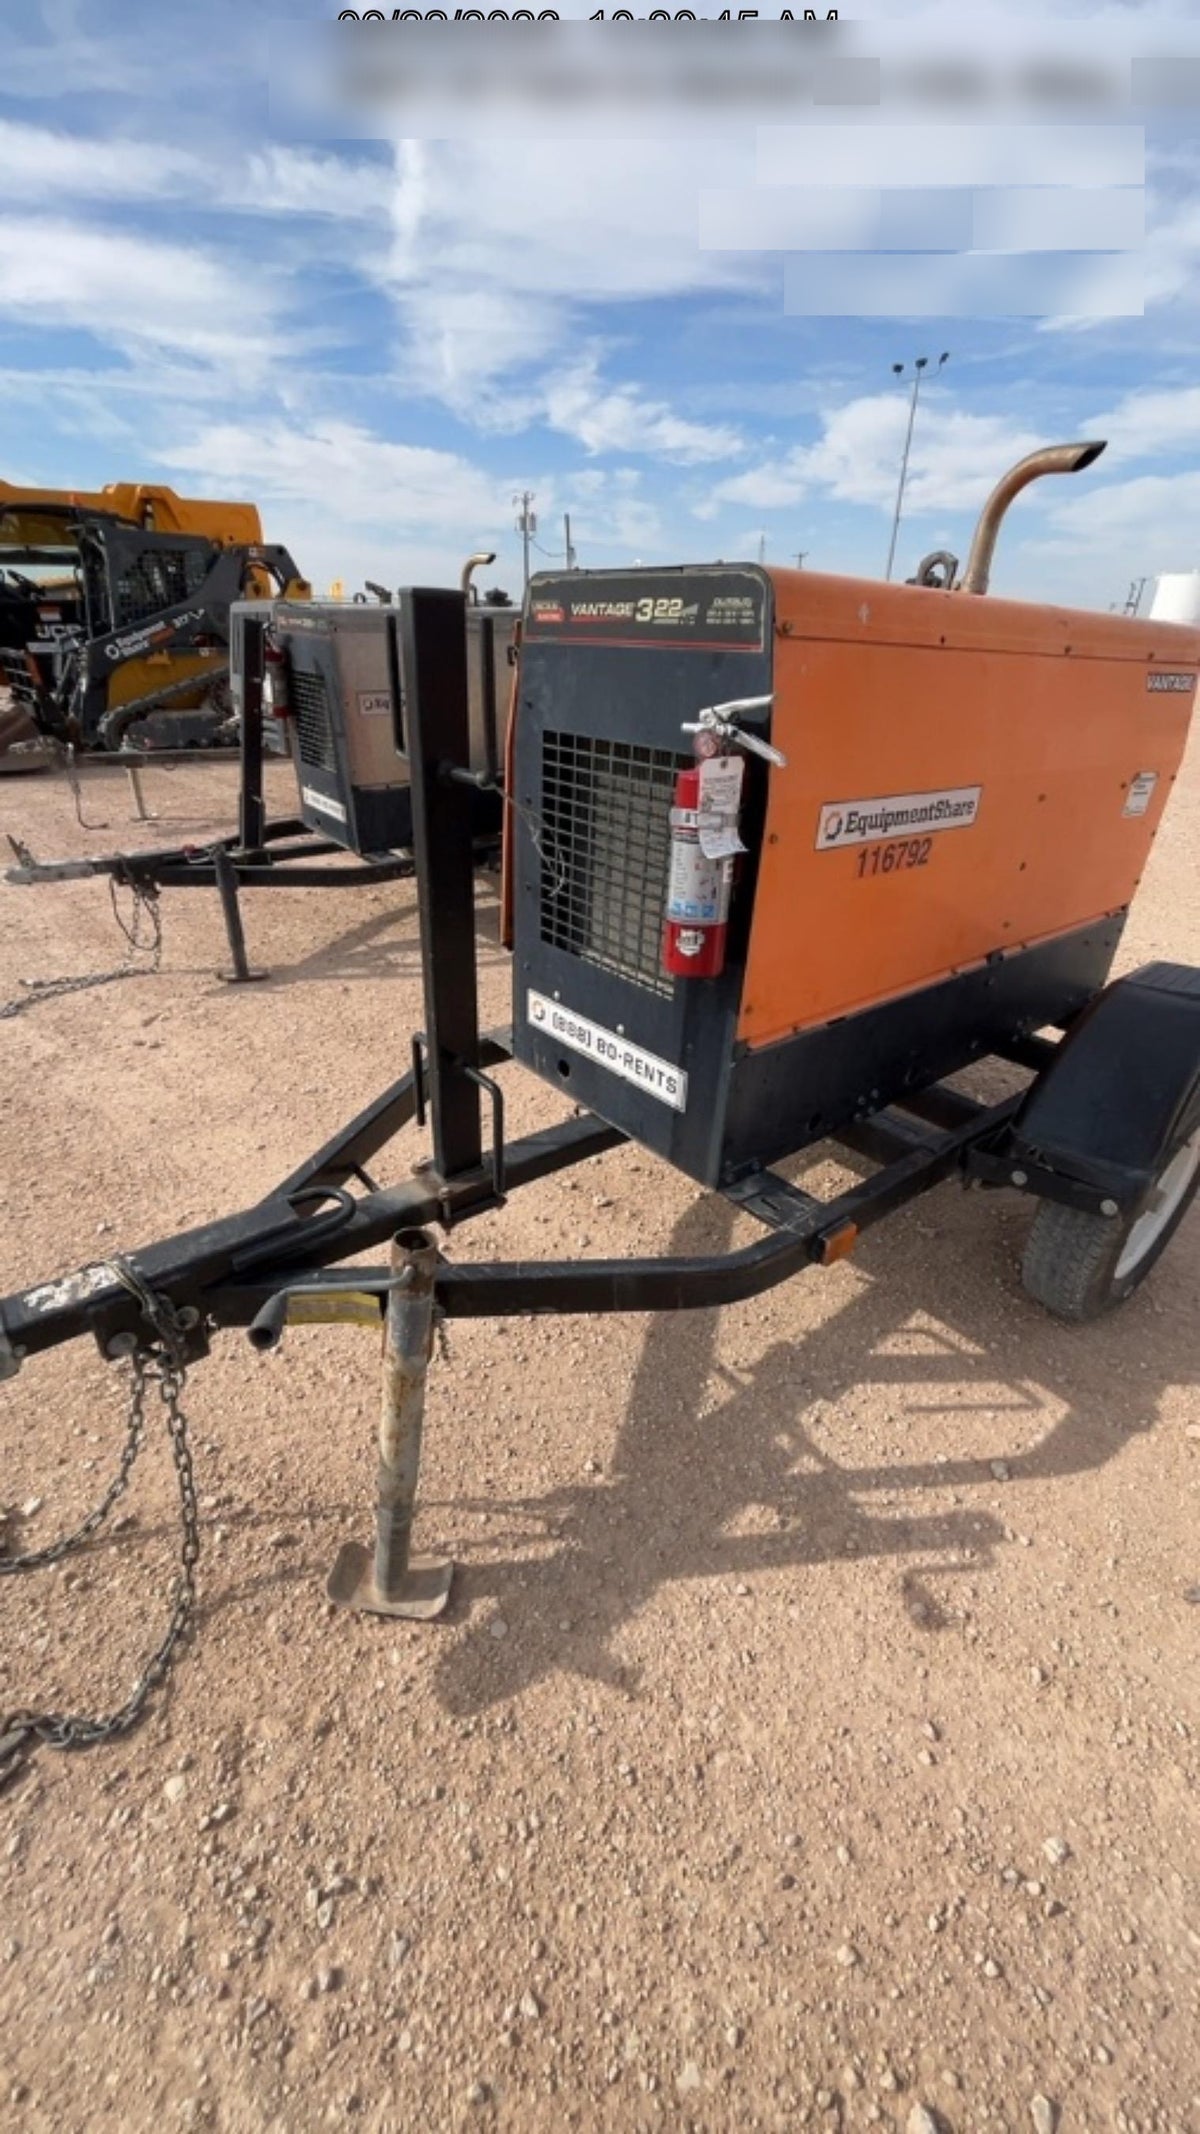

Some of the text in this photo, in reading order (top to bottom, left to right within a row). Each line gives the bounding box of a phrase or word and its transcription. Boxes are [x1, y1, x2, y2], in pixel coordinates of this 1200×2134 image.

[570, 601, 635, 617] VANTAGE
[635, 597, 684, 622] 322
[1147, 674, 1193, 690] VANTAGE
[844, 799, 976, 837] EquipmentShare
[857, 836, 933, 878] 116792
